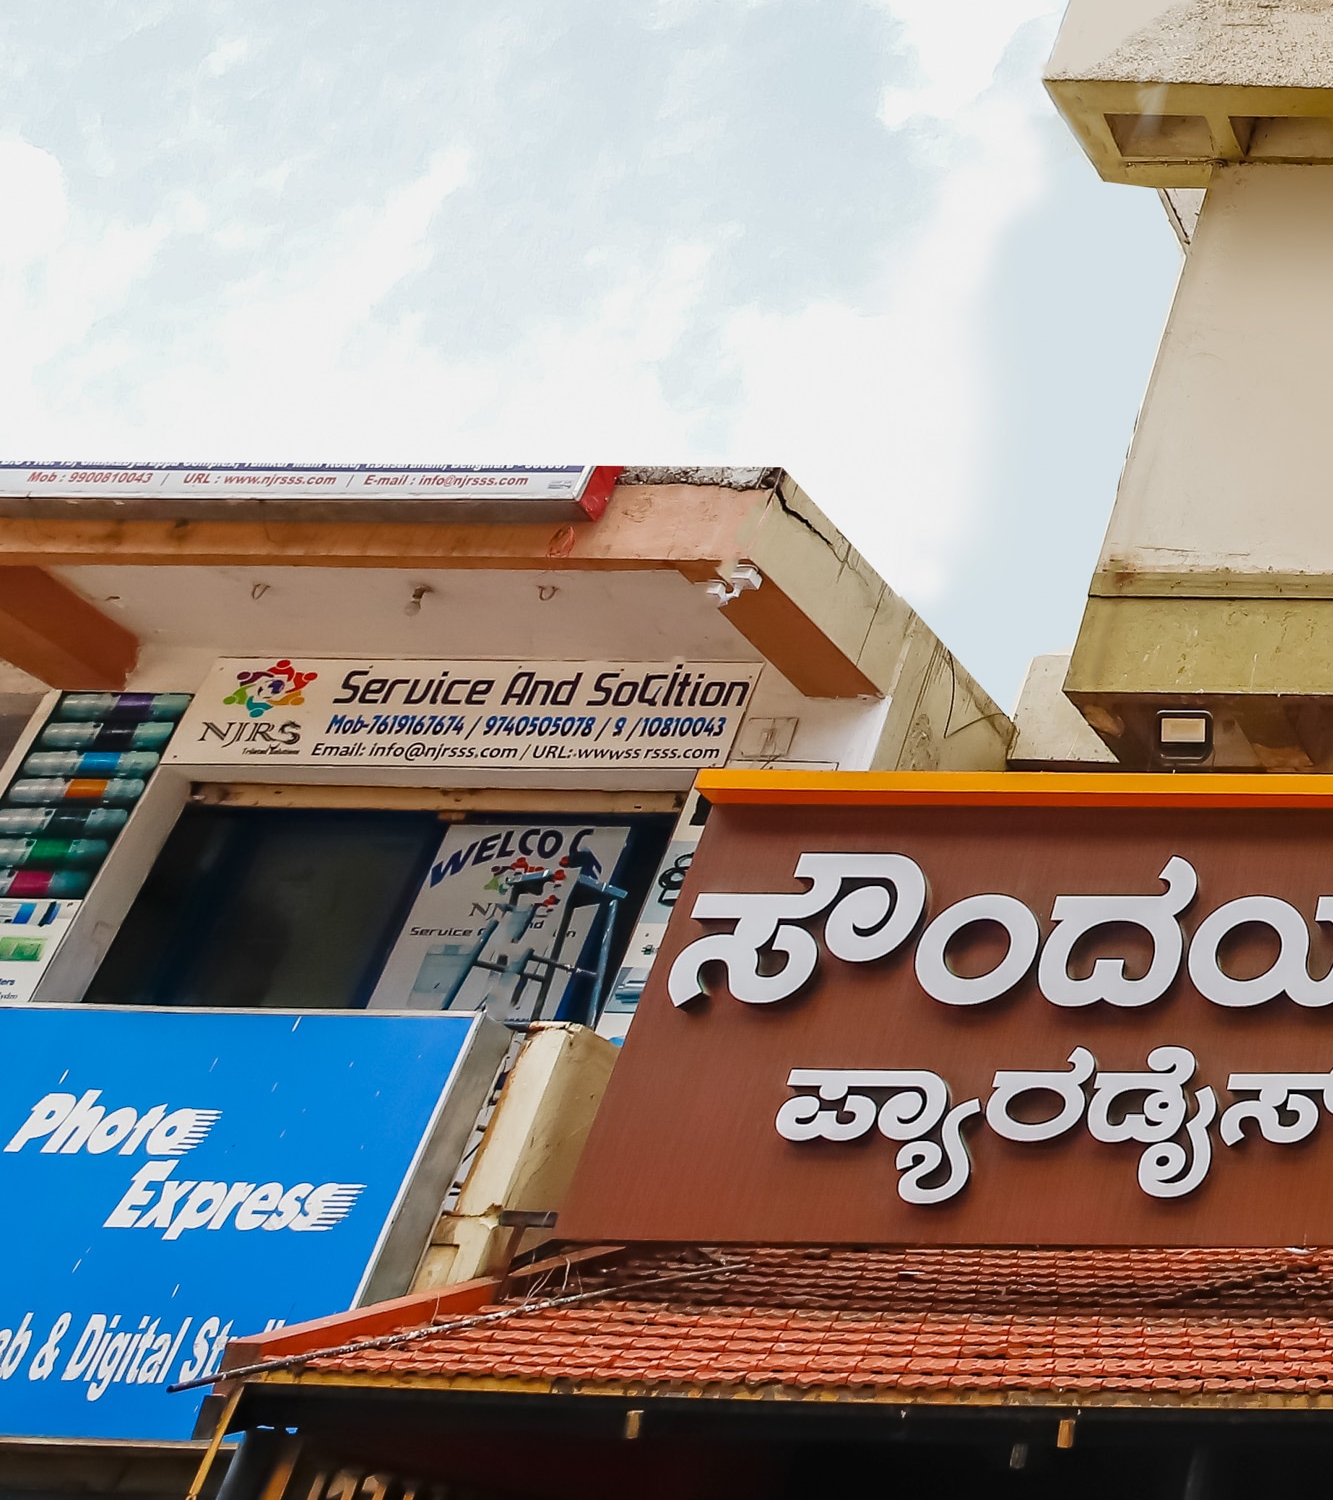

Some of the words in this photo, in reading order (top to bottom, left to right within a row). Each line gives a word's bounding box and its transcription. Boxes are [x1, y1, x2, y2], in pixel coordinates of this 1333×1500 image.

[27, 472, 57, 483] Mob
[68, 472, 153, 484] 9900810043
[183, 473, 210, 484] URL
[224, 473, 336, 488] www.njrsss.com
[363, 475, 407, 486] E-mail
[418, 475, 529, 488] info@njrsss.com
[332, 671, 496, 705] Service
[501, 672, 583, 706] And
[483, 716, 597, 737] 9740505078
[311, 743, 363, 757] Email:
[368, 743, 518, 761] info@njrsss.com
[429, 828, 602, 888] WELCO
[3, 1089, 223, 1156] Photo
[103, 1159, 368, 1240] Express
[28, 1311, 72, 1381] &
[61, 1313, 194, 1402] Digital
